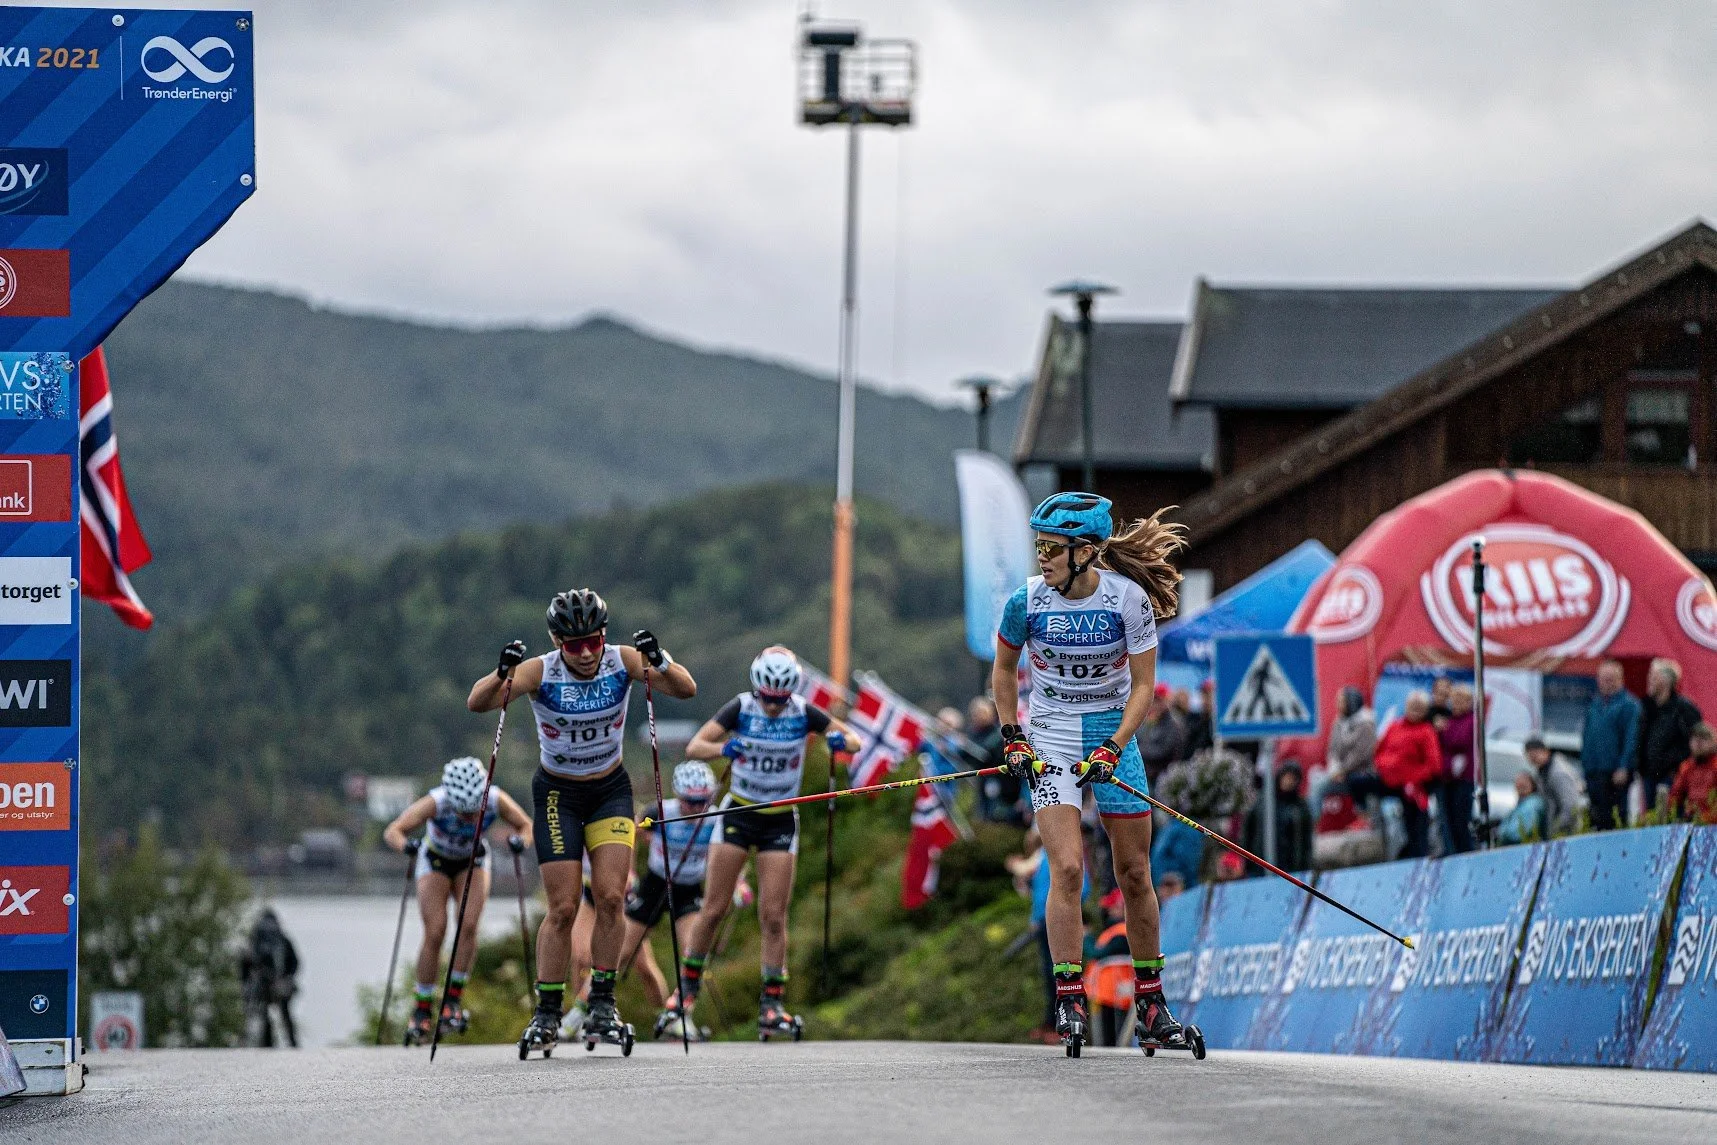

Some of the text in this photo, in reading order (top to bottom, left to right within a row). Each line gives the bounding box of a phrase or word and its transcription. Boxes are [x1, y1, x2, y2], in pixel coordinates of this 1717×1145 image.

[36, 47, 100, 69] 2021
[1070, 613, 1110, 632] VVS
[1046, 630, 1113, 645] EKSPERTEN
[1058, 648, 1120, 662] Byggtorget
[1054, 663, 1109, 680] 102
[578, 680, 612, 701] VVS
[560, 695, 616, 712] EKSPERTEN
[565, 723, 612, 744] 101
[1537, 911, 1658, 981] VVS EKSPERTEN
